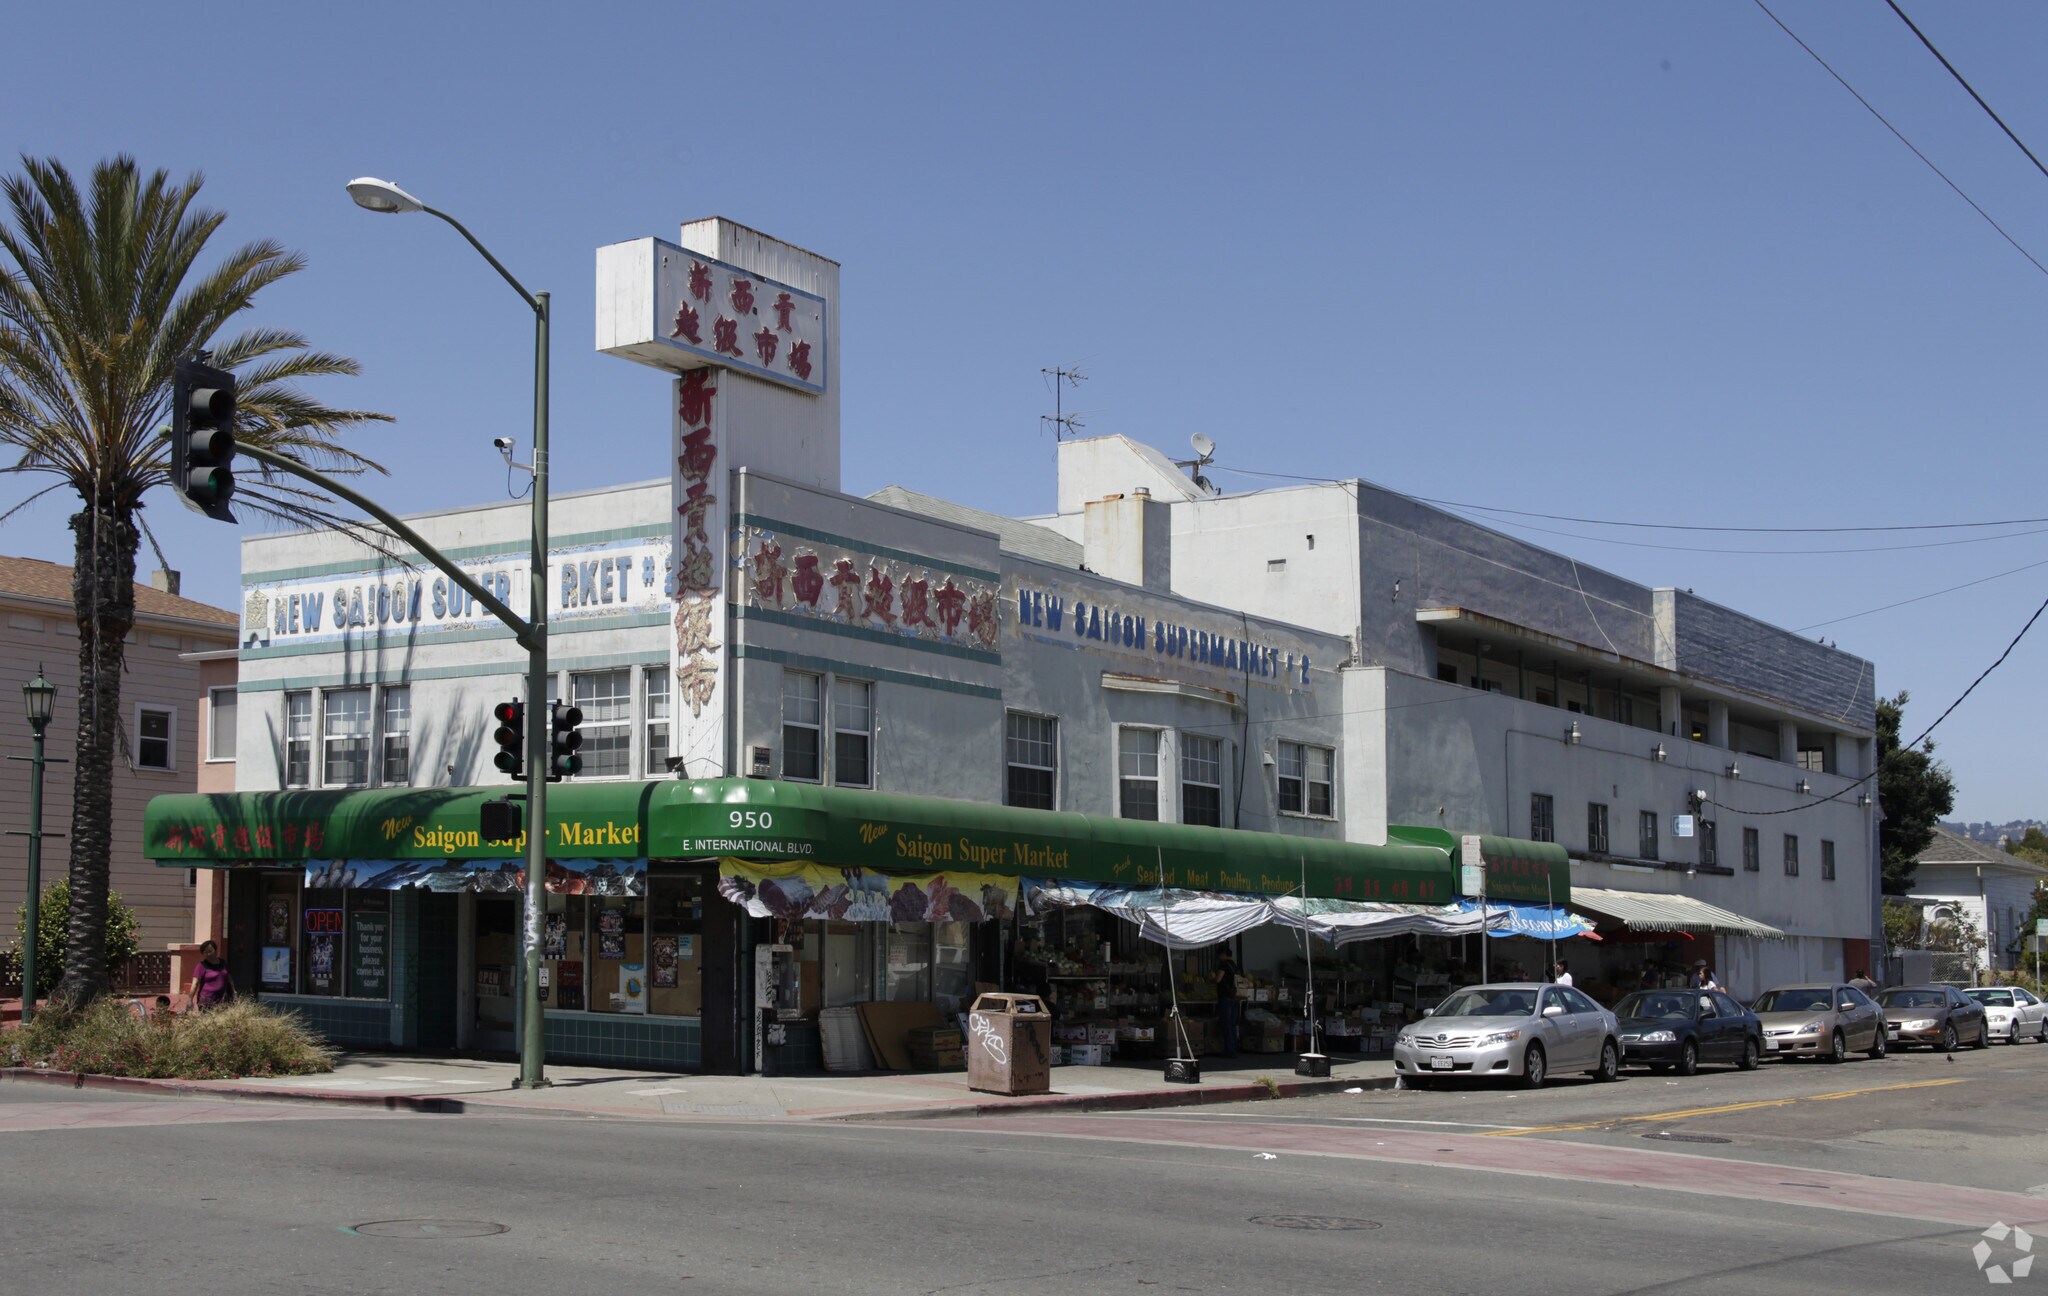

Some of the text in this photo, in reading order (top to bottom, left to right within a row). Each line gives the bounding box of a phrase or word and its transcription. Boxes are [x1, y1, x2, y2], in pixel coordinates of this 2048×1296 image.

[275, 592, 323, 634] NEW
[333, 579, 422, 629] SAIGON
[1018, 589, 1063, 631] NEW
[1075, 602, 1145, 650] SAIGON
[1155, 621, 1279, 679] SUPERMARKET
[729, 811, 773, 829] 950
[381, 815, 412, 840] New
[414, 825, 479, 854] Saigon
[559, 821, 641, 846] Market
[682, 839, 814, 855] E. INTERNATIONAL BLVD.
[860, 822, 1069, 869] New Saigon Super Market
[1187, 869, 1208, 886] Meat
[1220, 870, 1251, 890] Poultry
[1261, 874, 1295, 892] Produce
[306, 911, 344, 931] OPEN
[356, 922, 374, 932] Thank
[360, 933, 382, 944] for your
[362, 955, 380, 967] please
[356, 967, 384, 976] come back
[478, 970, 498, 984] OPEN
